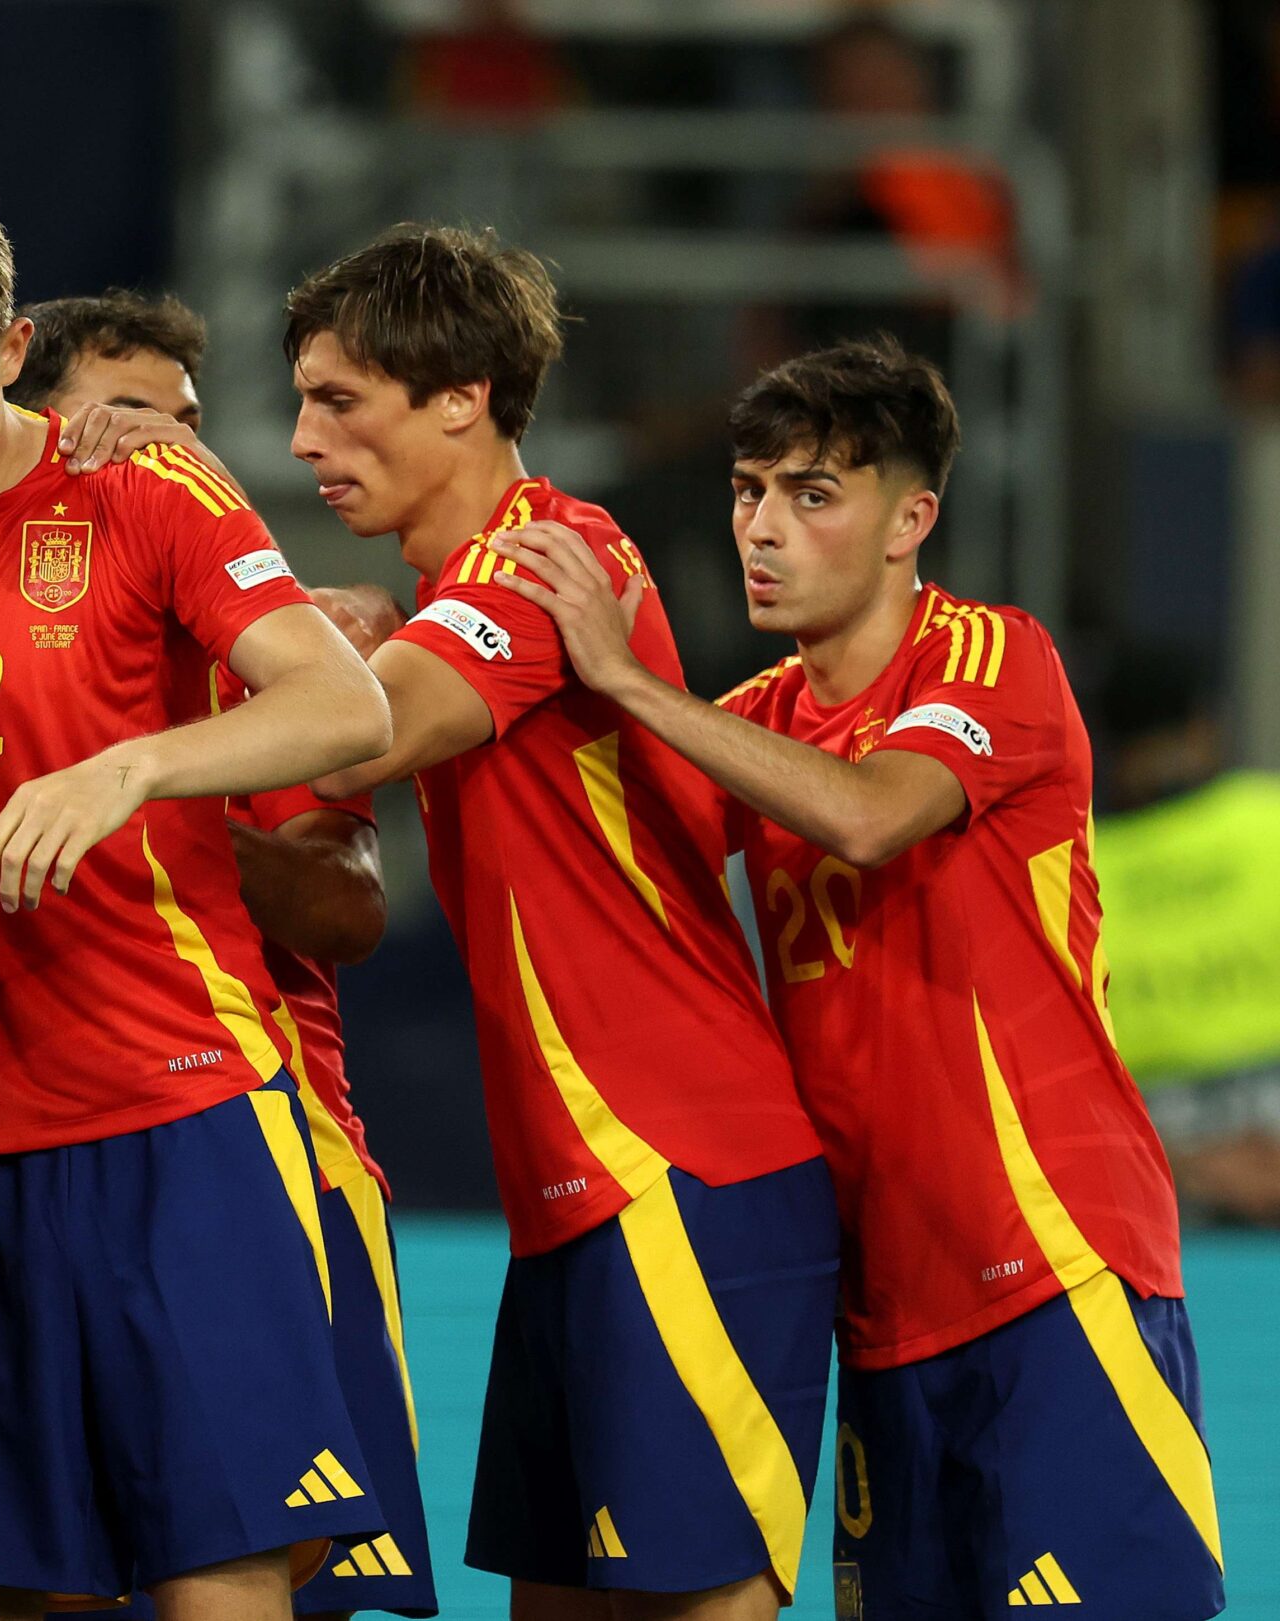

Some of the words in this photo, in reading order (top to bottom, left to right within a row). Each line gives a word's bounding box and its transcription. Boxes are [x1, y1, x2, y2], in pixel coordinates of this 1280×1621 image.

[228, 559, 246, 571] UEFA
[233, 559, 287, 579] FOUNDAT
[29, 624, 48, 633] SPAIN
[54, 624, 79, 633] FRANCE
[39, 633, 56, 641] JUNE
[58, 633, 75, 641] 2025
[35, 641, 71, 649] STUTTGART
[766, 854, 862, 984] 20
[168, 1049, 223, 1072] HEAT.RDY
[542, 1176, 587, 1200] HEAT.RDY
[981, 1258, 1024, 1282] HEAT.RDY
